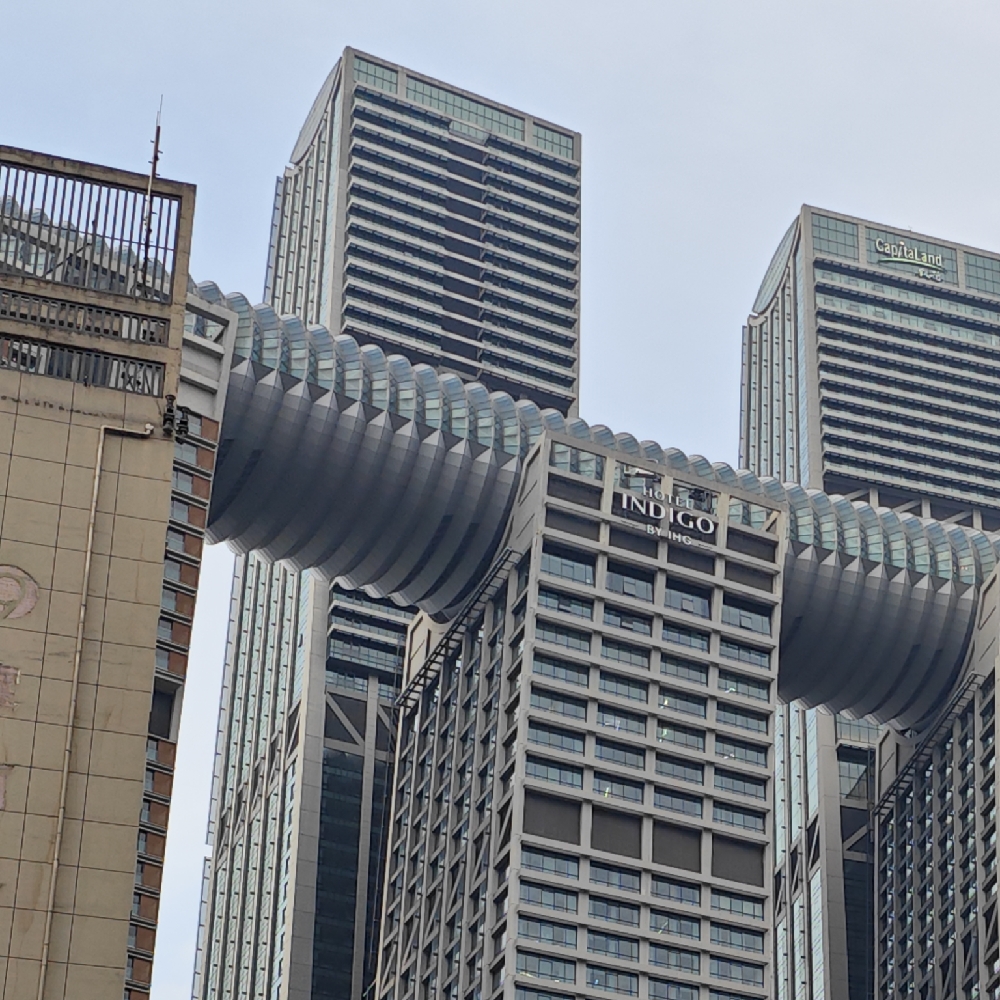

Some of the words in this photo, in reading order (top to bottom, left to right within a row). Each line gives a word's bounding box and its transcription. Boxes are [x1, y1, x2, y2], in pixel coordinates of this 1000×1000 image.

[875, 238, 942, 266] CapitaLand
[643, 487, 694, 510] HOTEL
[621, 493, 715, 534] INDIGO
[646, 524, 662, 537] BY
[668, 530, 692, 545] IHG
